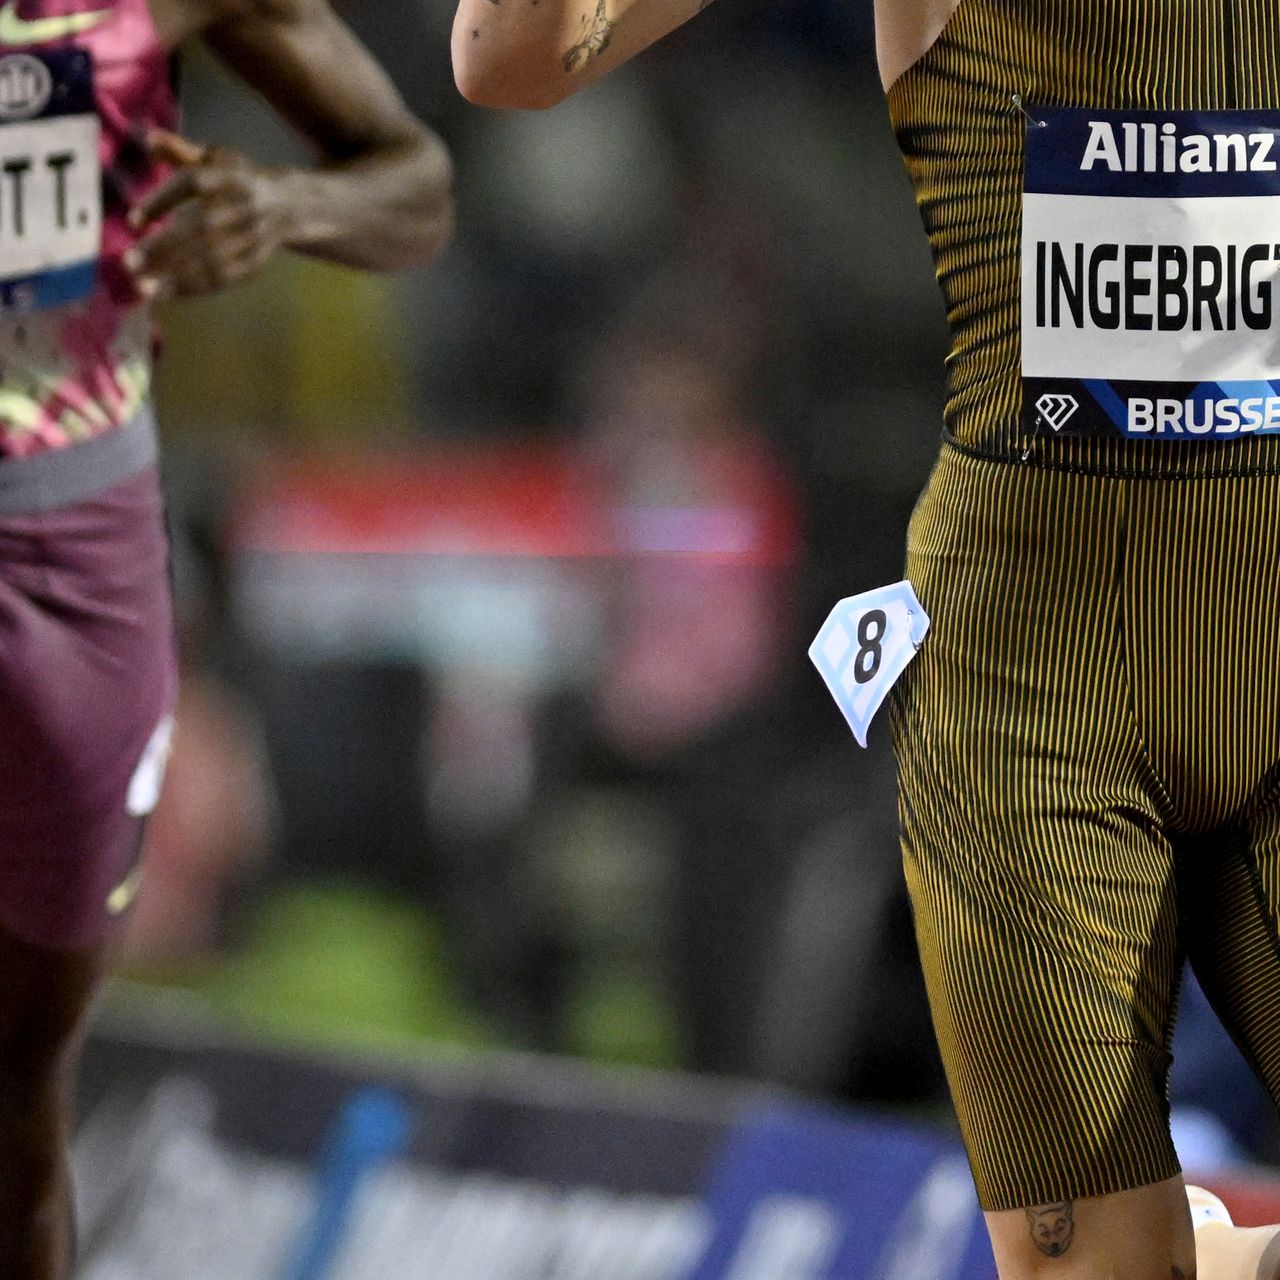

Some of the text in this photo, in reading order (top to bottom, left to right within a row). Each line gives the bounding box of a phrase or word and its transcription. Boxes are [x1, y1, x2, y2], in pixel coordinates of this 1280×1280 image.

[1079, 121, 1277, 173] Allianz
[46, 151, 89, 229] T.
[854, 609, 887, 684] 8
